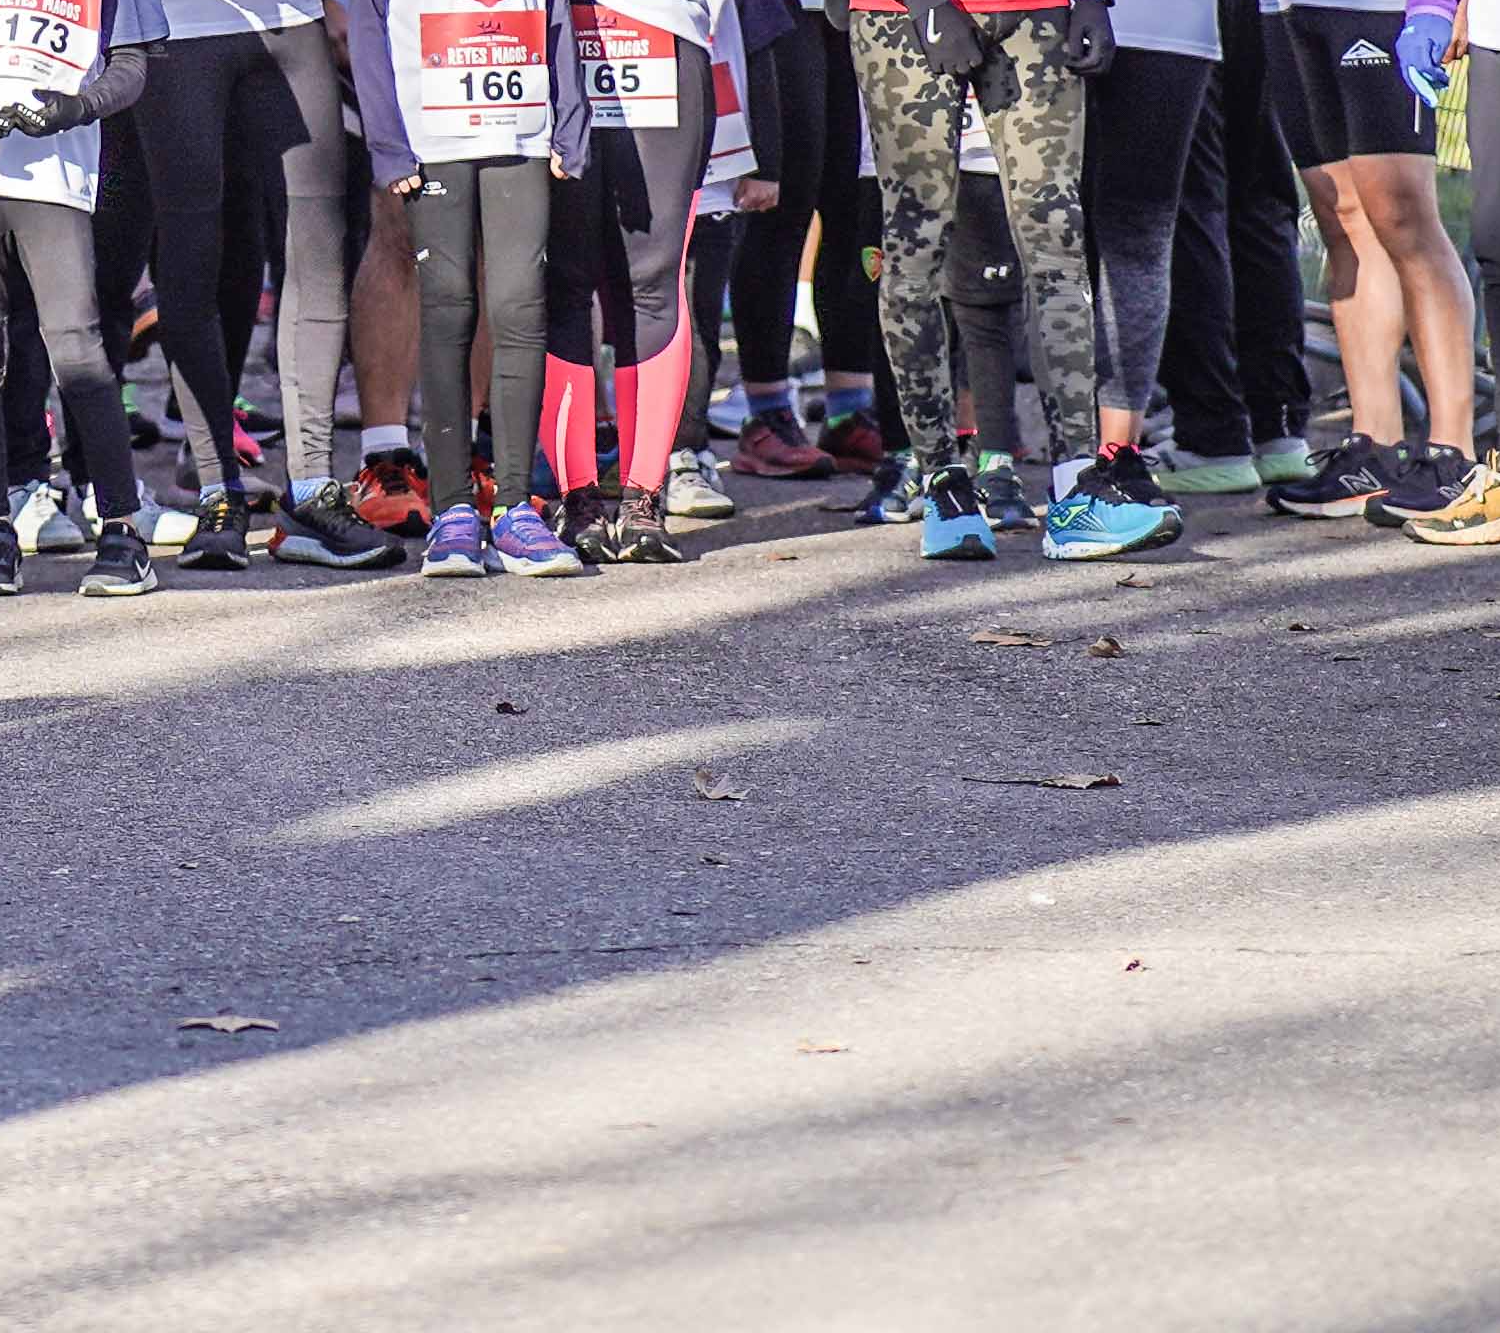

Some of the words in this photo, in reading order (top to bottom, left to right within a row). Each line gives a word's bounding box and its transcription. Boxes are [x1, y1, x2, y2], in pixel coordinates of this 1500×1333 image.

[5, 13, 70, 53] 173
[447, 46, 488, 65] REYES
[491, 45, 528, 65] MAGOS
[578, 39, 601, 57] YES
[459, 70, 524, 102] 166
